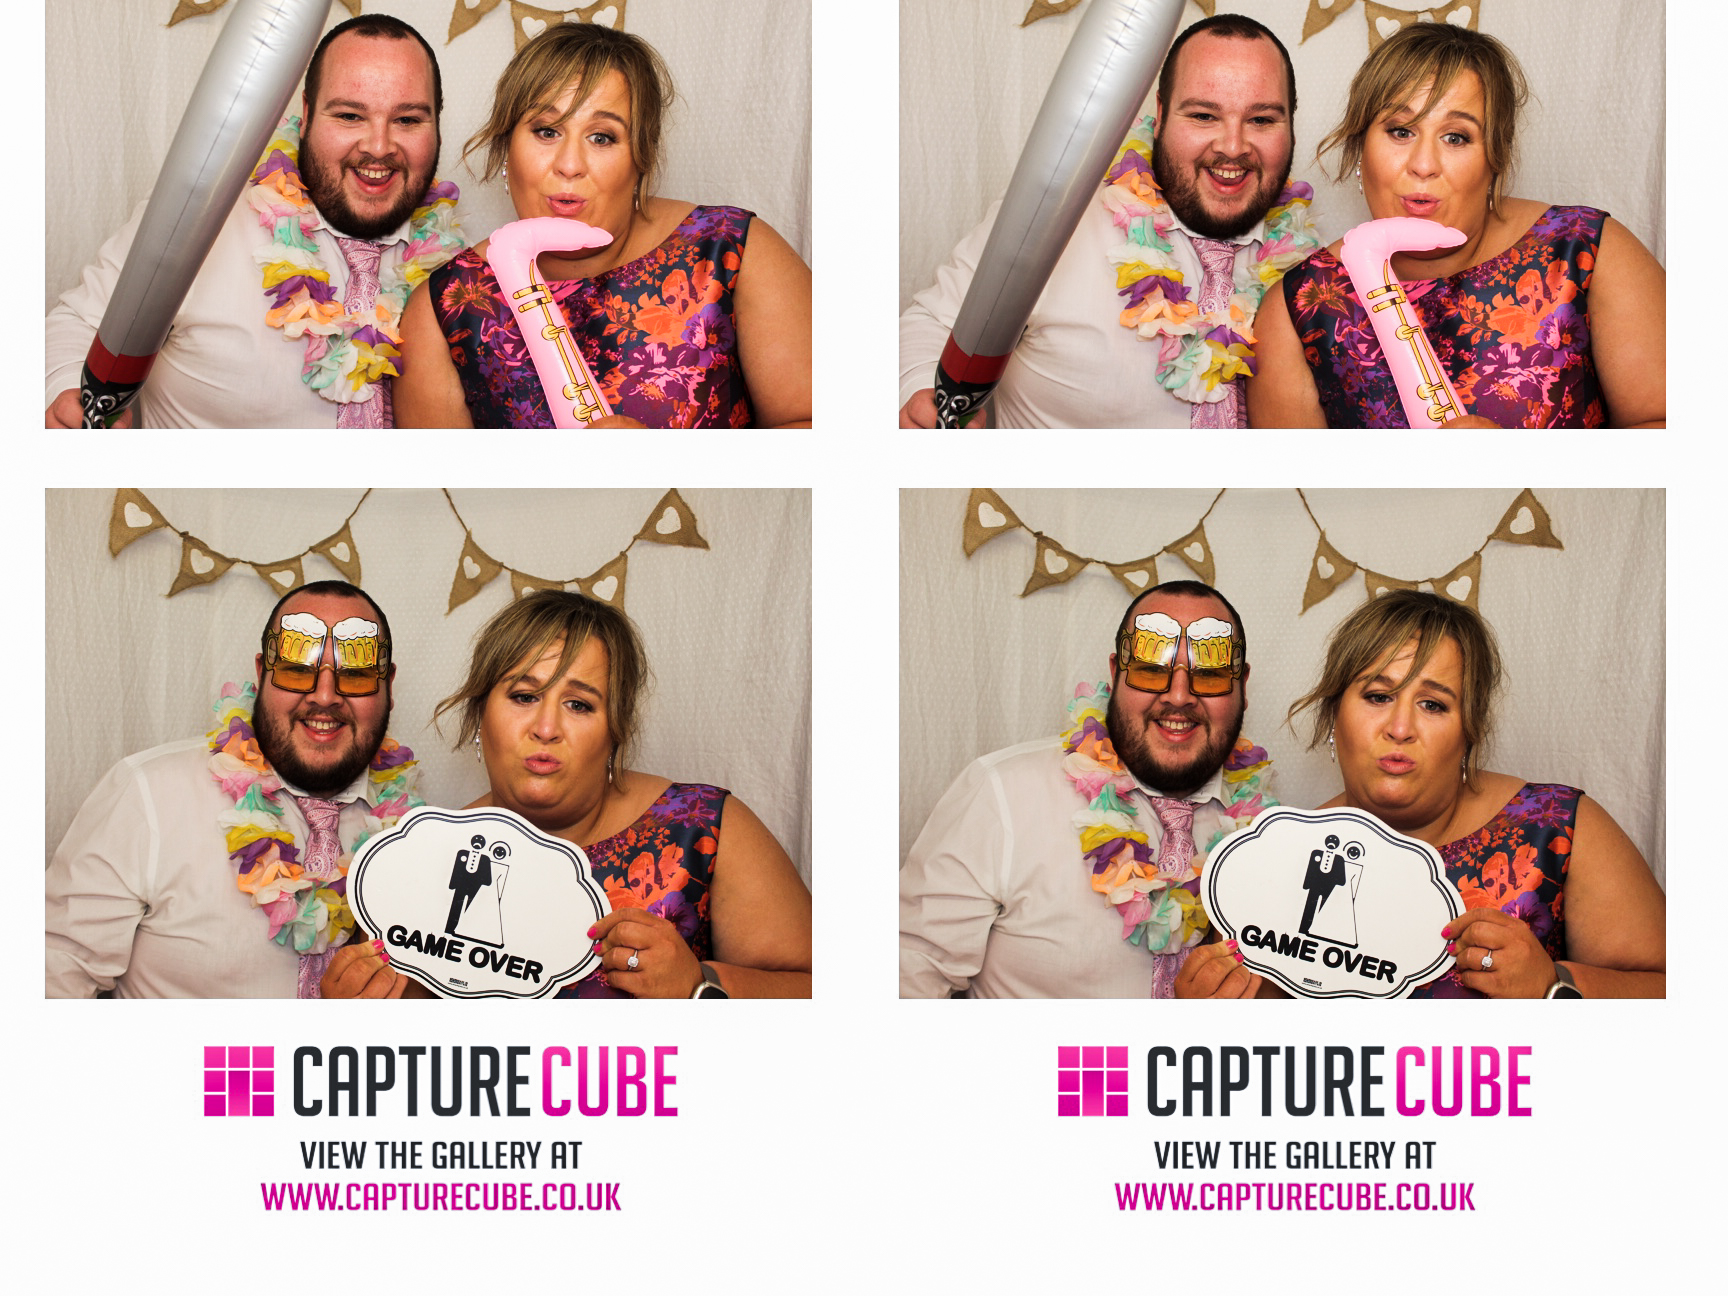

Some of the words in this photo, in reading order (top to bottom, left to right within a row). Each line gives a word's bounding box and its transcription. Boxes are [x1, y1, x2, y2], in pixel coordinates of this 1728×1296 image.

[386, 924, 464, 963] GAME
[468, 946, 543, 984] OVER
[1240, 924, 1318, 963] GAME
[1322, 946, 1397, 984] OVER
